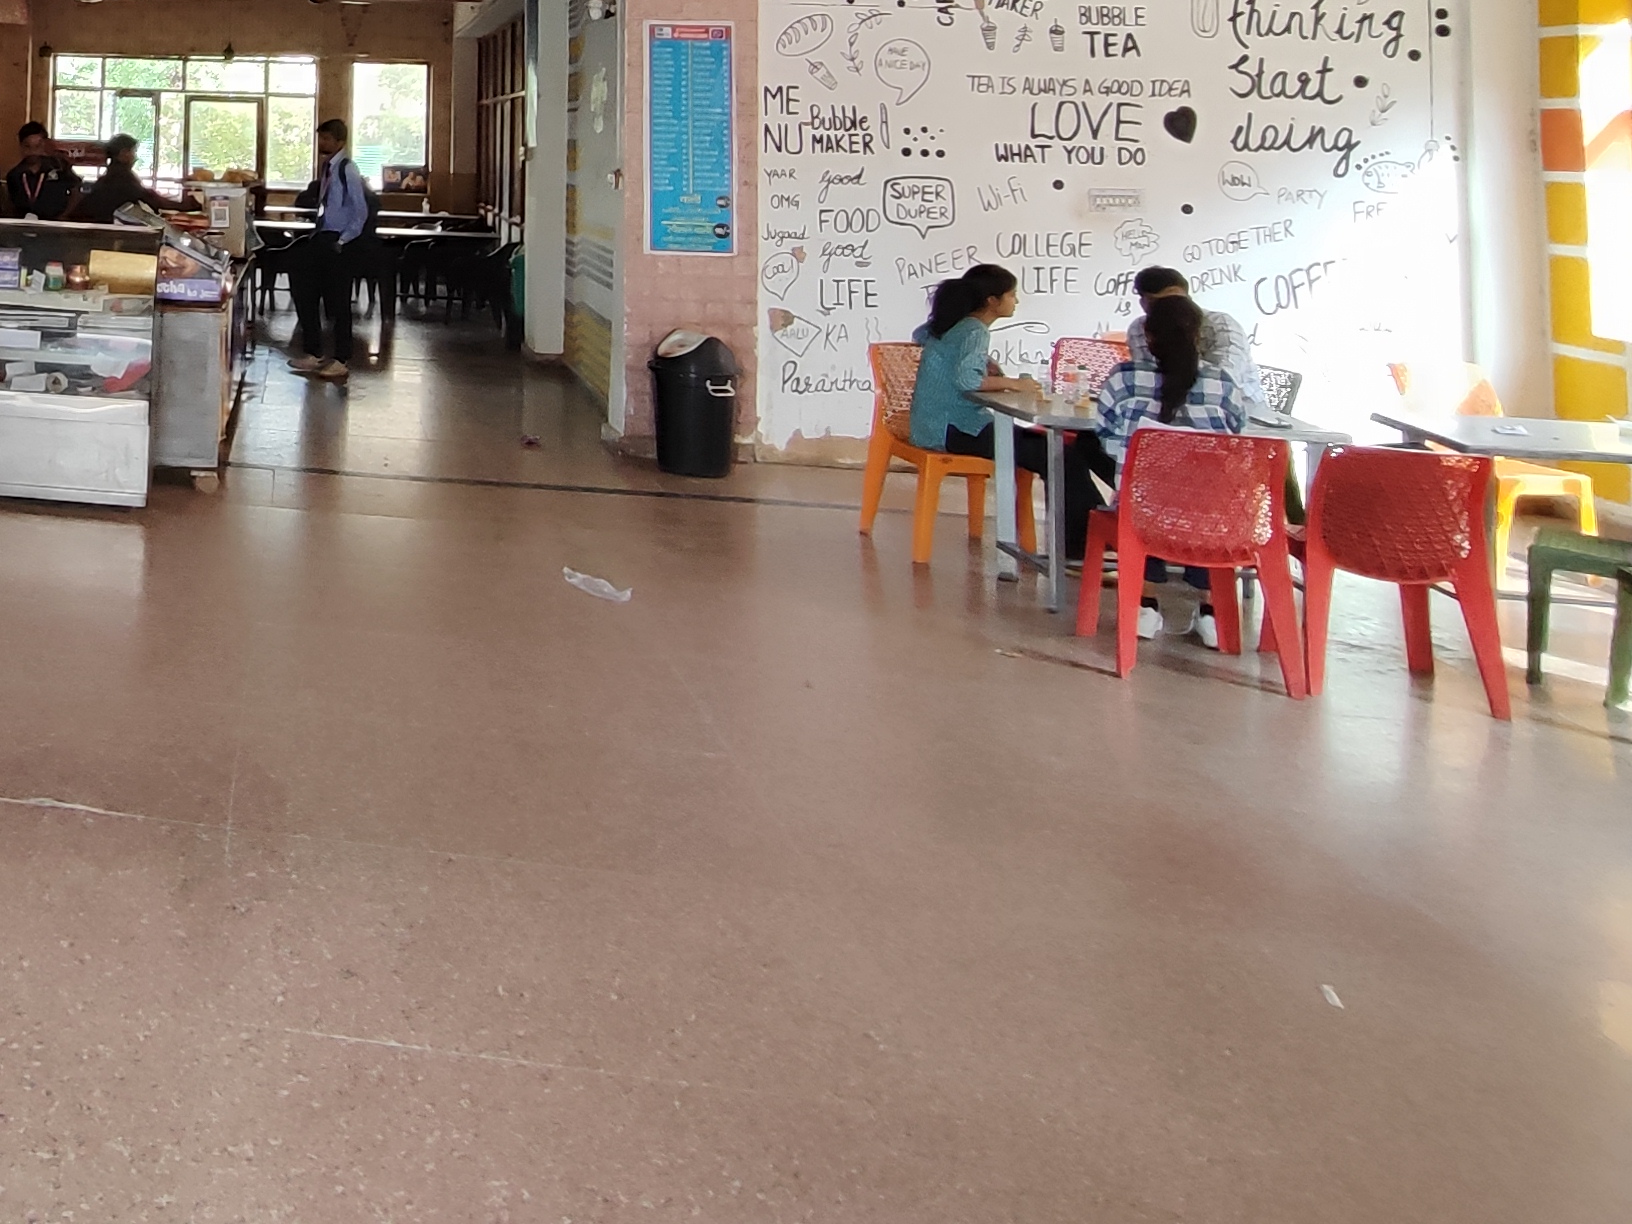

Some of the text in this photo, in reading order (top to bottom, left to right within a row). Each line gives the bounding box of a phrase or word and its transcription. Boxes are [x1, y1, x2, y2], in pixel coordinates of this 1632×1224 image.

[1078, 5, 1147, 26] BUBBLE
[1081, 31, 1141, 58] TEA
[967, 75, 1191, 98] TEA IS ALWAYS A GOOD IDEA
[1227, 54, 1343, 105] Start
[764, 85, 800, 116] ME
[810, 103, 870, 132] Bubble
[1030, 100, 1143, 143] LOVE
[764, 123, 803, 155] NU
[811, 133, 875, 155] MAKER
[1230, 112, 1361, 178] doing
[995, 143, 1146, 166] WHAT YOU DO
[764, 168, 797, 186] YAAR
[770, 194, 800, 210] OMG
[890, 182, 946, 203] SUPER
[977, 175, 1028, 212] Wi-Fi
[1277, 187, 1328, 209] PARTY
[819, 208, 881, 233] FOOD
[896, 203, 949, 220] DUPER
[996, 231, 1093, 259] COLLEGE
[1182, 218, 1295, 263] GO TOGETHER
[895, 245, 983, 285] PANEER
[1190, 263, 1246, 294] DRINK
[1021, 266, 1081, 294] LIFE
[820, 278, 879, 311] LIFE
[1114, 298, 1131, 316] is
[824, 323, 849, 352] KA
